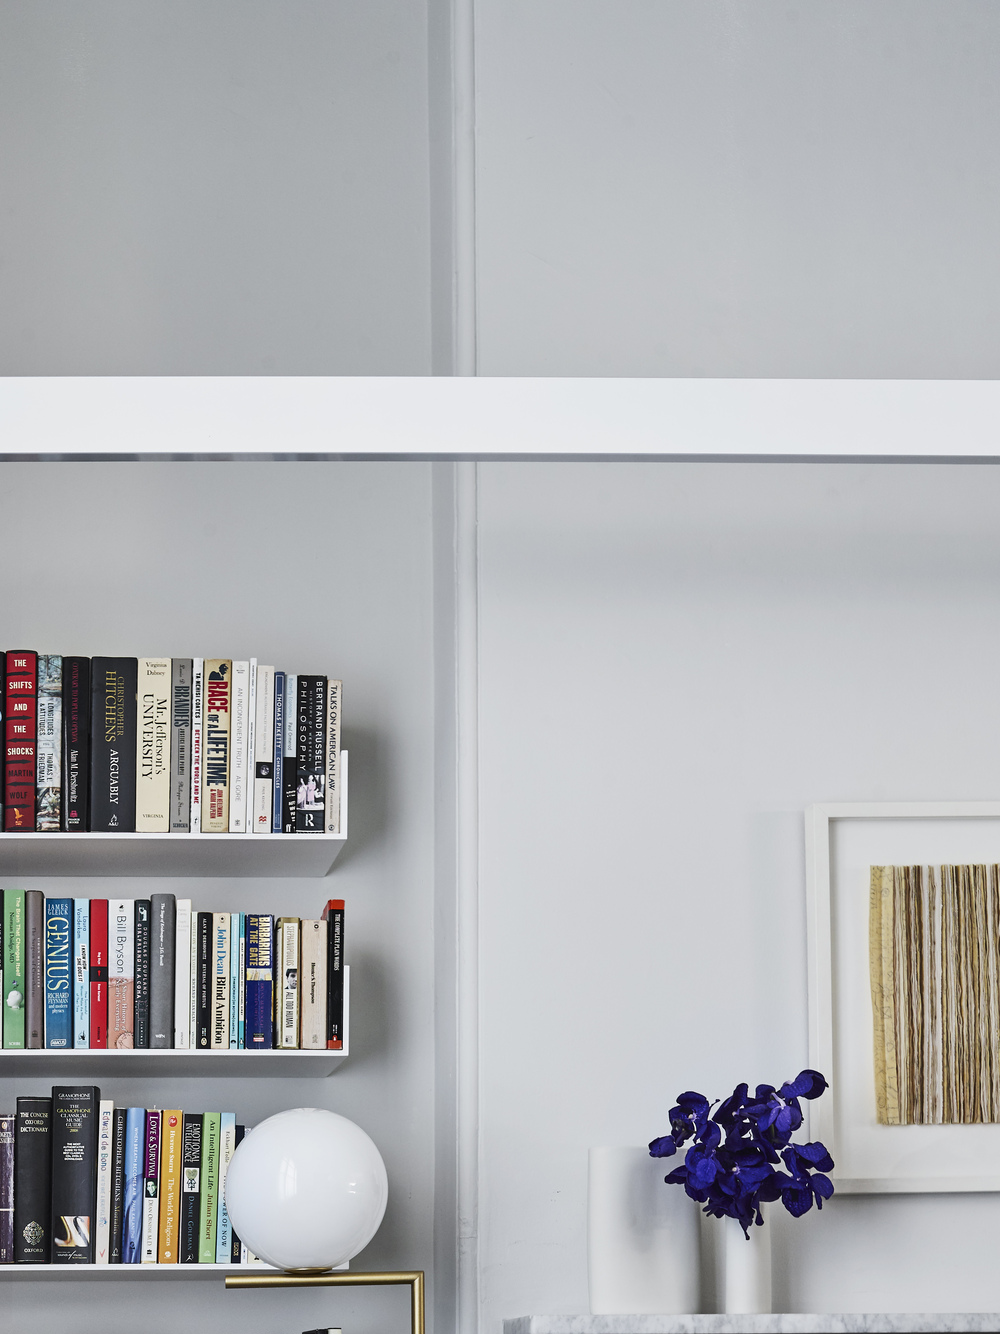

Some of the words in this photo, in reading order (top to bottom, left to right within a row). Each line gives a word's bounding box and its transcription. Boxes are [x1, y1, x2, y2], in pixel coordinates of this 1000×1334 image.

[105, 671, 116, 742] HITCHENS
[156, 699, 167, 718] Mr.
[174, 686, 190, 727] BRANDEIS
[208, 681, 228, 713] RACE
[315, 681, 323, 729] BERTRAND
[208, 715, 219, 723] OF
[299, 681, 307, 771] PHILOSOPHY
[330, 712, 337, 725] ON
[142, 694, 153, 780] UNIVERSITY
[155, 720, 166, 774] Jefferson's
[207, 730, 227, 786] LIFETIME
[109, 749, 118, 804] ARGUABLY
[117, 916, 126, 932] Bill
[216, 927, 226, 949] John
[250, 918, 258, 927] AT
[250, 930, 258, 944] THE
[47, 917, 69, 990] GENIUS
[115, 937, 126, 973] Bryson
[250, 948, 258, 966] GATE
[259, 917, 270, 966] BARBARIANS
[216, 951, 226, 974] Dean
[216, 977, 226, 1000] Blind
[215, 1002, 225, 1044] Ambition
[102, 1112, 110, 1138] Edward
[102, 1141, 108, 1150] de
[192, 1124, 200, 1162] EMOTIONAL
